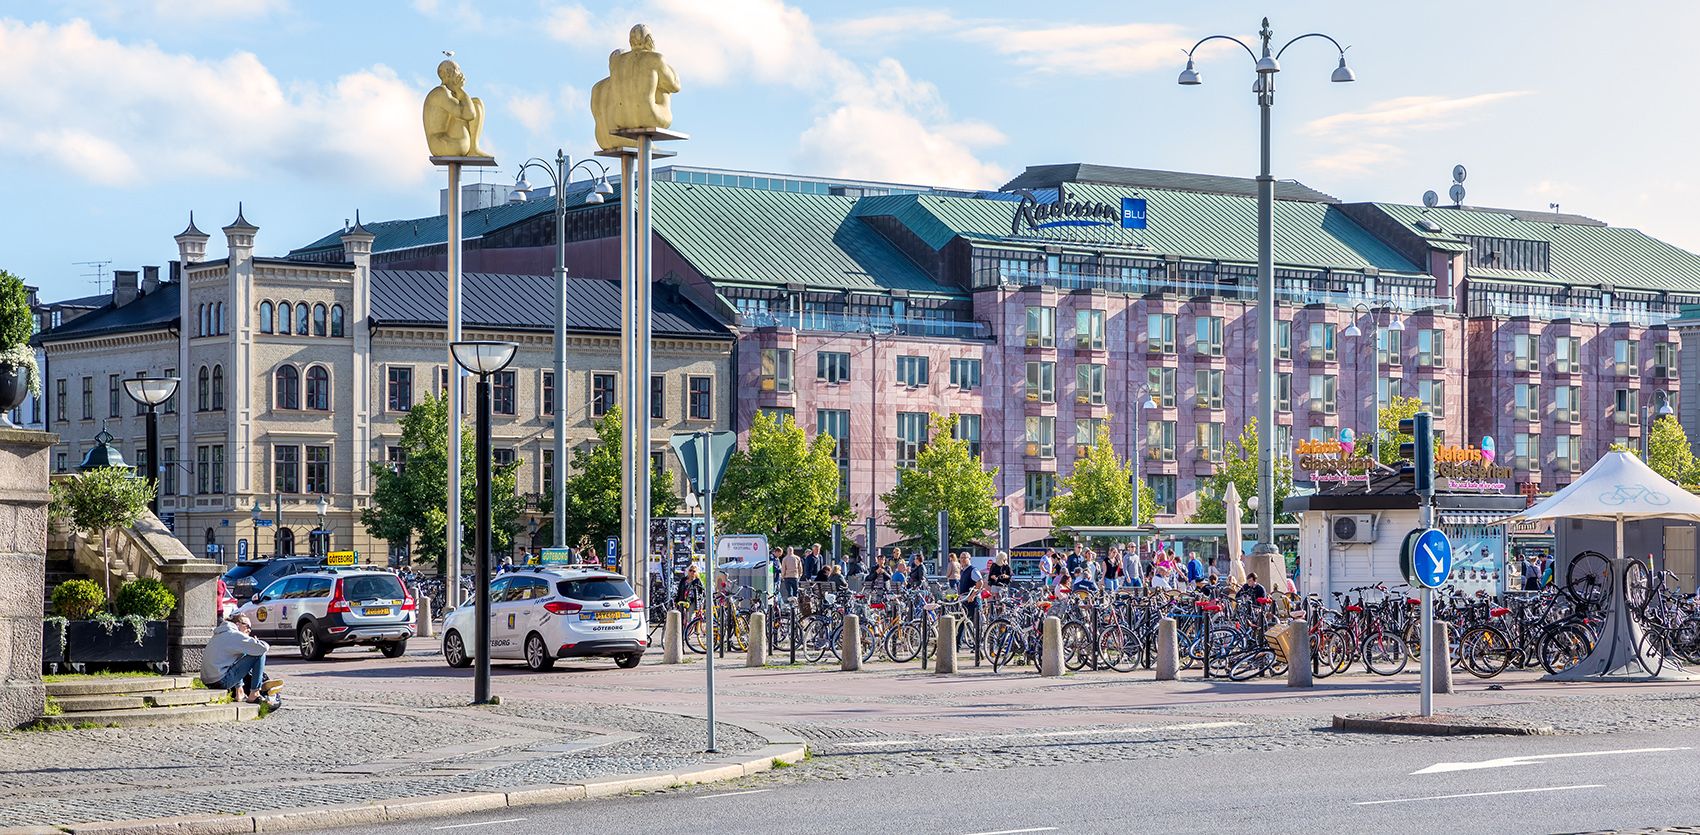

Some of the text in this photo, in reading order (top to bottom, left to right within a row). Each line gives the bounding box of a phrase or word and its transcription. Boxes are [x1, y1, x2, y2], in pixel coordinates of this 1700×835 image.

[1012, 186, 1146, 234] Radisson BLU
[1296, 439, 1342, 454] Jafaris
[1434, 444, 1482, 462] Jafaris
[609, 541, 615, 555] P
[329, 552, 353, 564] GÖTEBORG
[542, 551, 569, 561] GÖTEBORG
